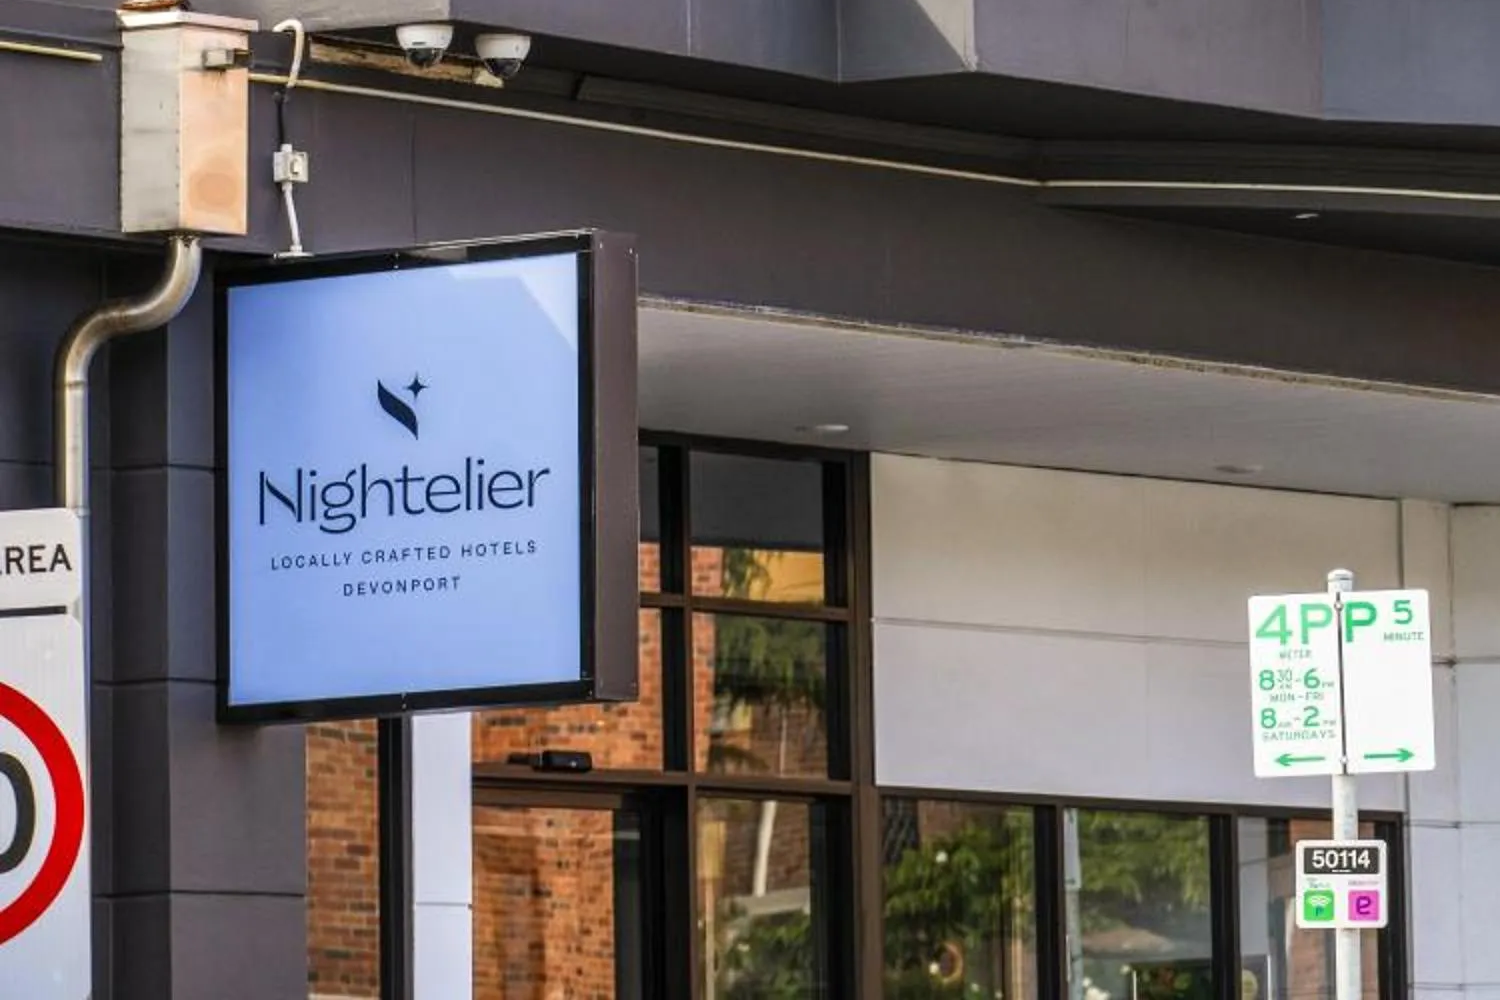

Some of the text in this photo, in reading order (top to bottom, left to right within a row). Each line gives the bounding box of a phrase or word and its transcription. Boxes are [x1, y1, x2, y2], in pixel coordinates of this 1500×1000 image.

[258, 456, 551, 534] Nightelier
[0, 543, 73, 576] REA
[270, 540, 538, 571] LOCALLY CRAFTED HOTELS
[342, 576, 462, 597] DEVONPORT
[1255, 602, 1333, 646] 4P
[1345, 599, 1413, 643] P 5
[1311, 849, 1371, 869] 50114
